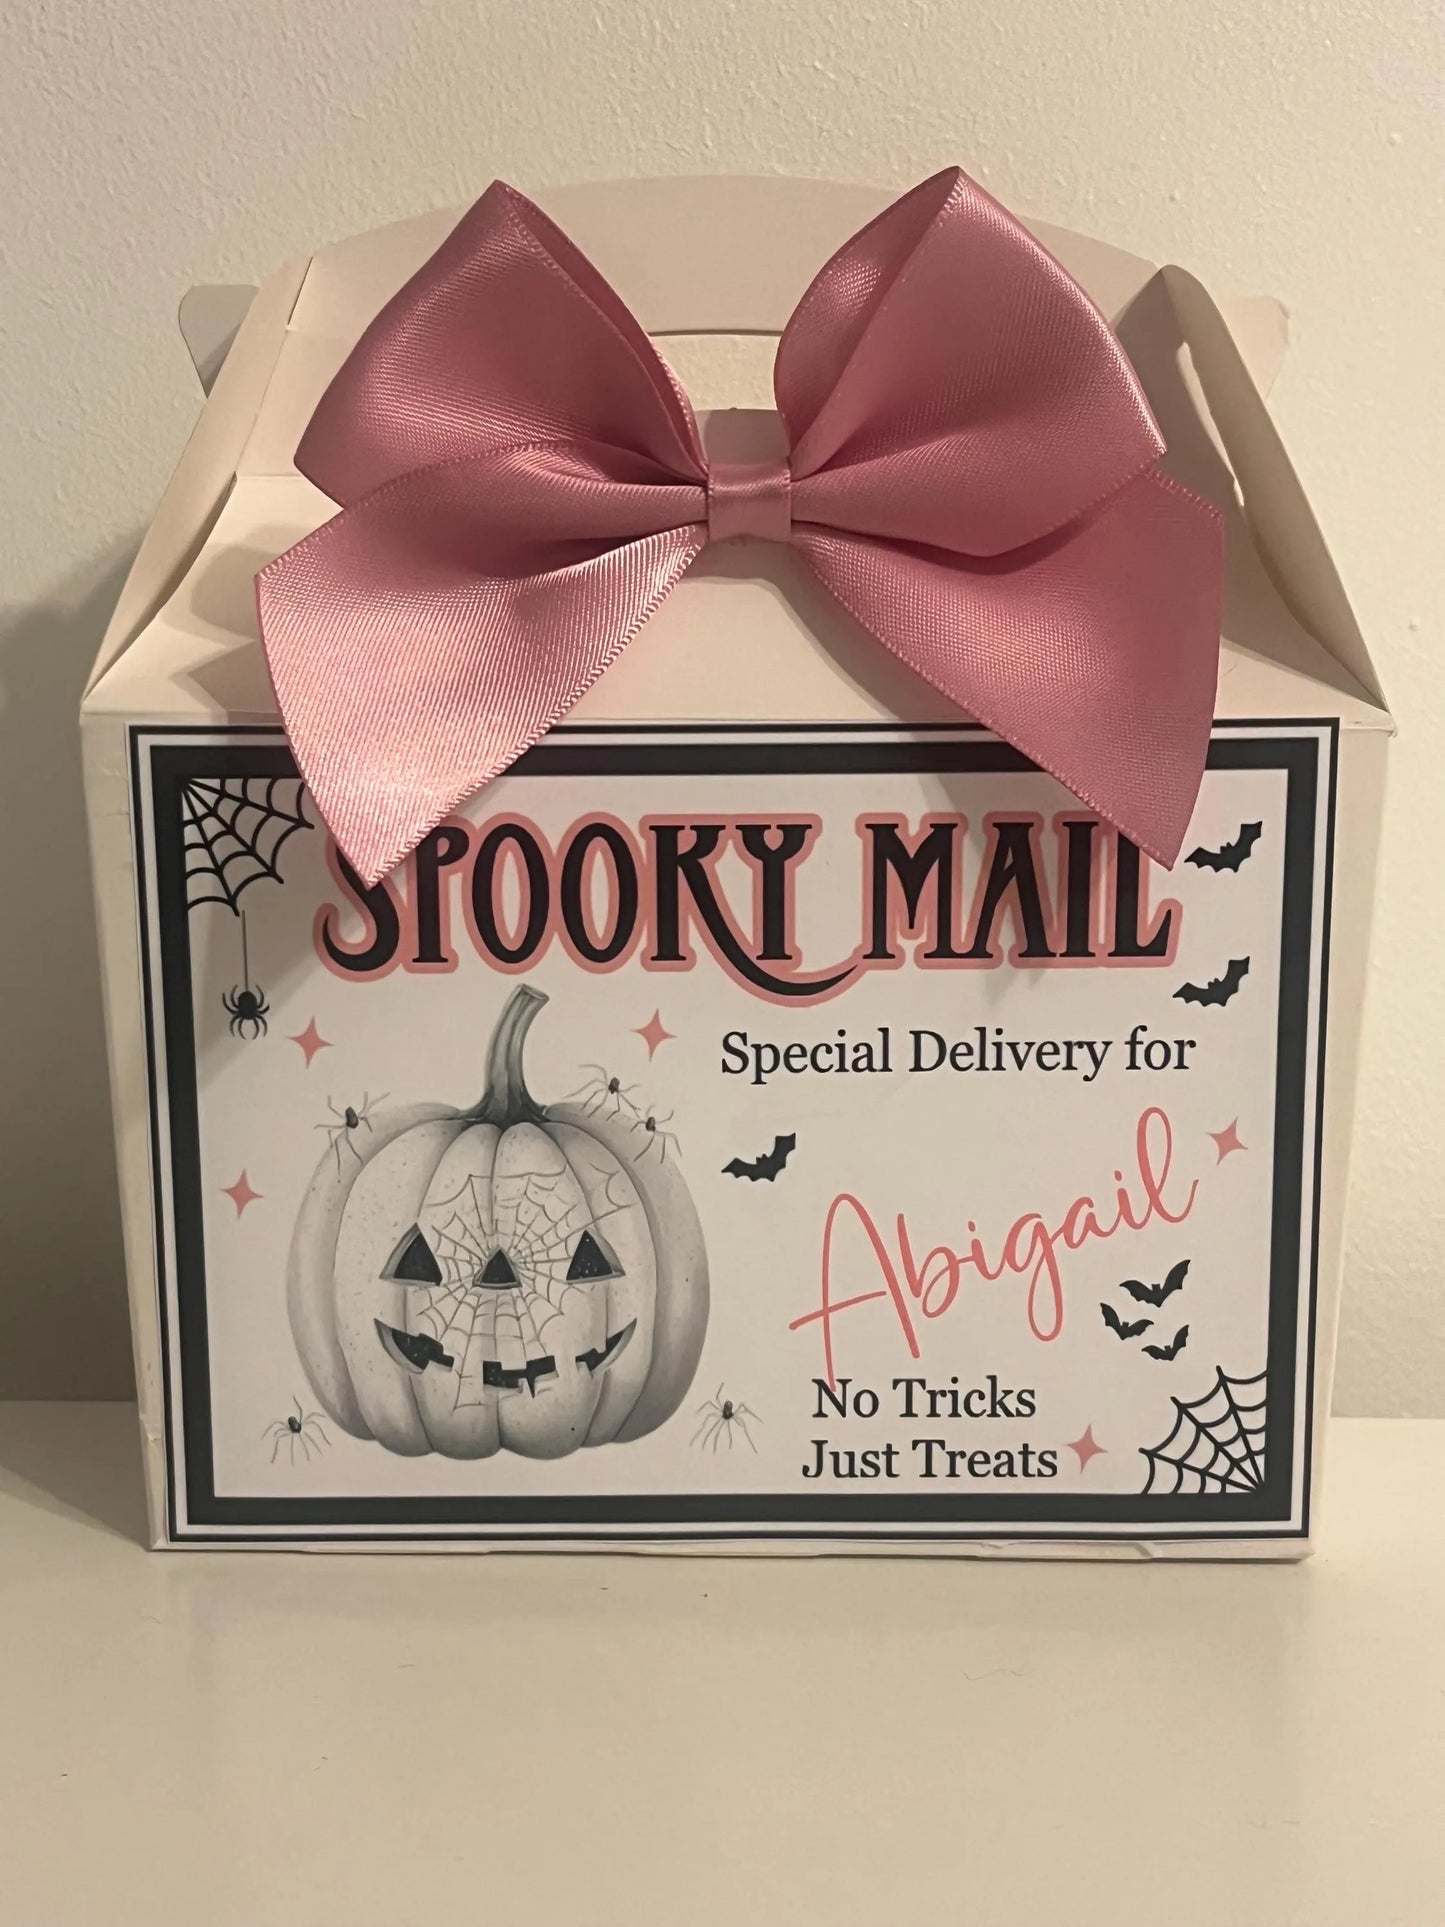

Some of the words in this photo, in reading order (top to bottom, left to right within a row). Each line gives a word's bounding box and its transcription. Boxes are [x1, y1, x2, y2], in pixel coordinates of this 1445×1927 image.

[861, 819, 1174, 960] MAIL
[720, 1027, 893, 1086] Special
[908, 1026, 1113, 1083] Delivery
[1123, 1024, 1197, 1071] for
[788, 1106, 1200, 1392] Abigail
[811, 1377, 880, 1419] No
[892, 1375, 1037, 1419] Tricks
[801, 1438, 900, 1479] Just
[911, 1438, 1058, 1479] Treats
